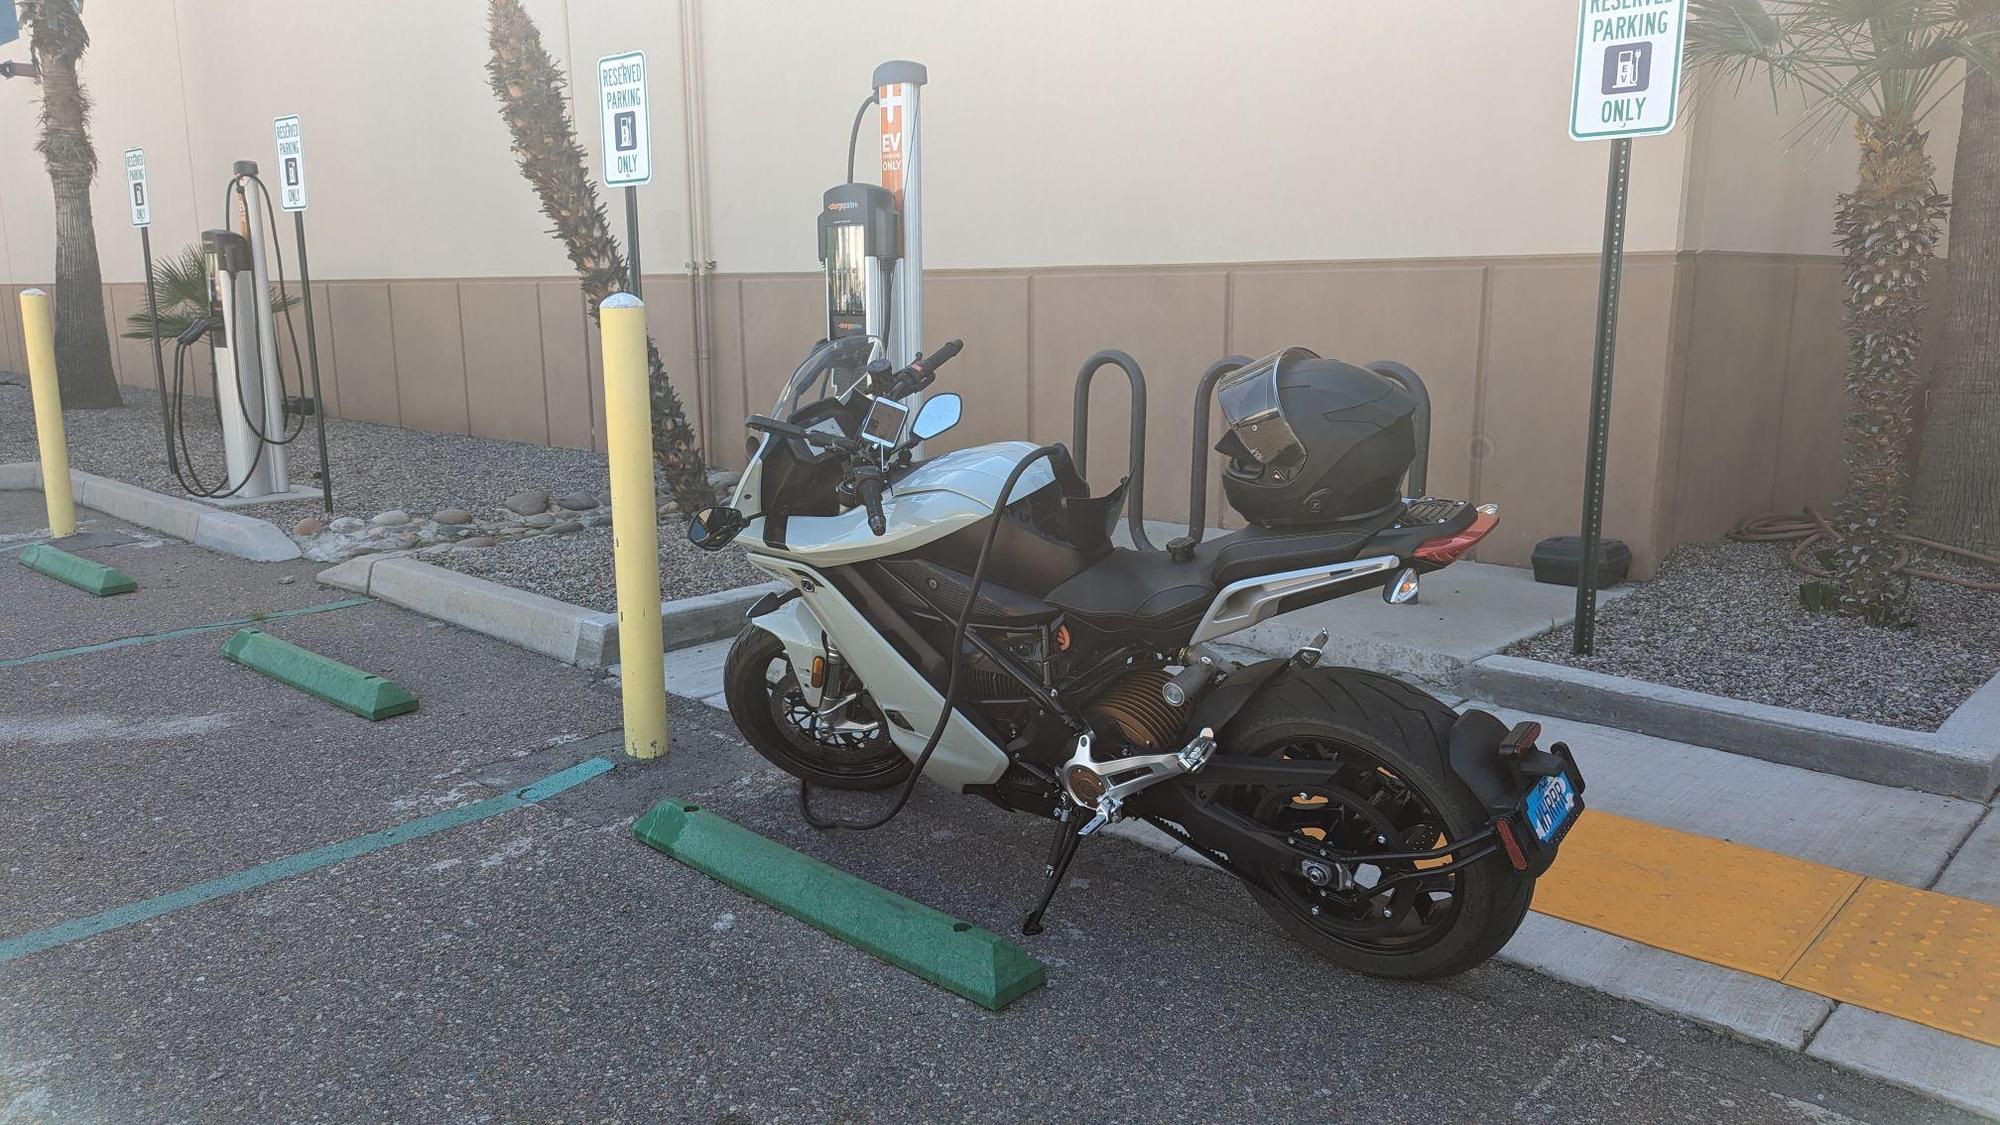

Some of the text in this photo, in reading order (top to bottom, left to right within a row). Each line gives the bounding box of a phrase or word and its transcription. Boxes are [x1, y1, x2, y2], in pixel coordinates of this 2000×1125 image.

[1592, 10, 1669, 42] PARKING
[602, 63, 642, 87] RESERVED
[606, 87, 641, 110] PARKING
[1601, 97, 1647, 124] ONLY
[882, 132, 901, 153] EV
[617, 153, 638, 174] ONLY
[883, 159, 901, 171] ONLY
